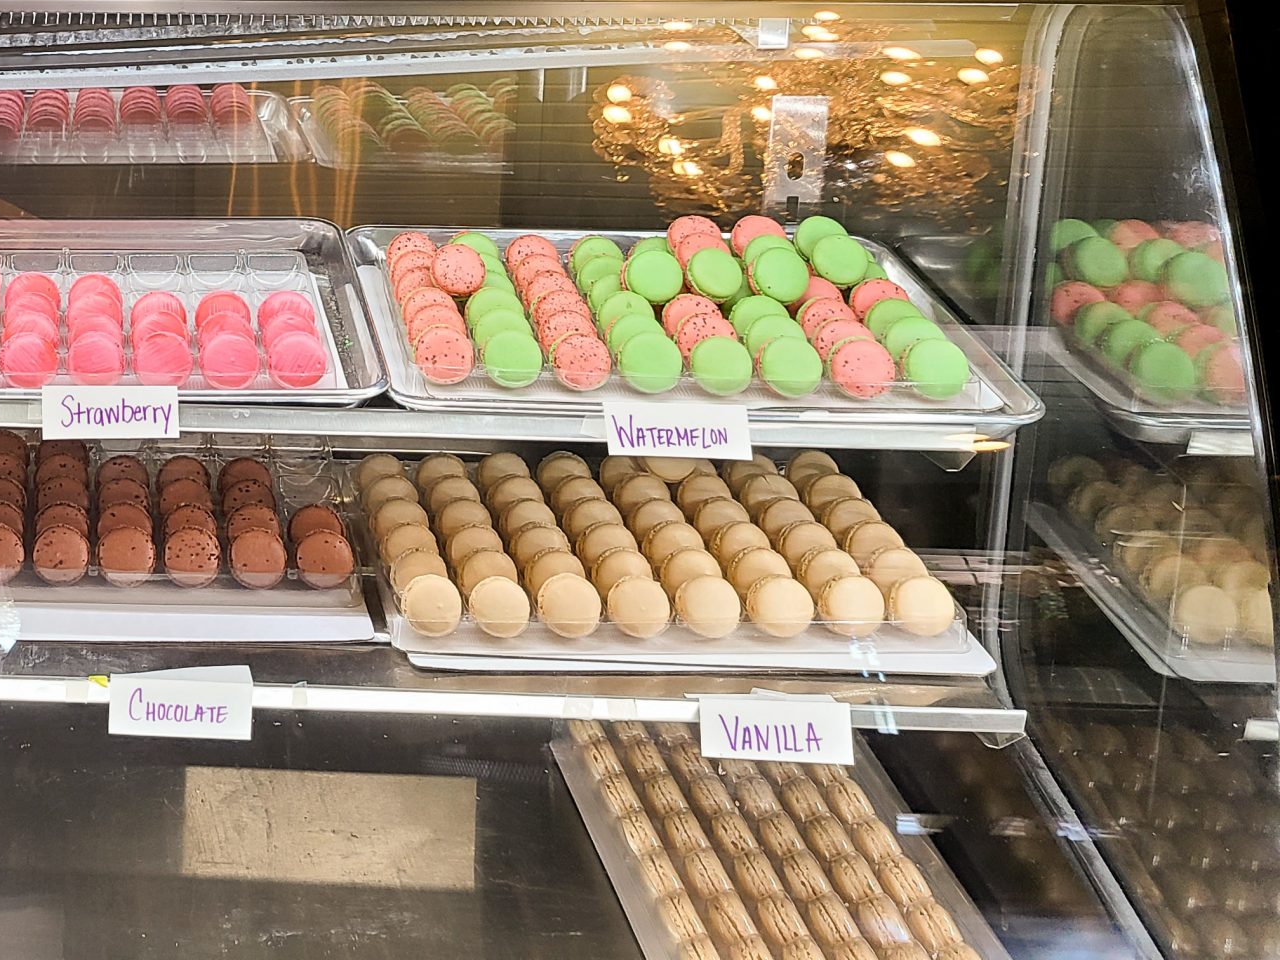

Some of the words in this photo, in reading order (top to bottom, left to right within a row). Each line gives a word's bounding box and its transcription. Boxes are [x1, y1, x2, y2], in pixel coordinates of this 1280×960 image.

[61, 395, 171, 434] Strawberry
[612, 414, 728, 449] WATERMELON
[129, 688, 228, 723] CHOCOLATE
[719, 714, 822, 753] VANILLA
